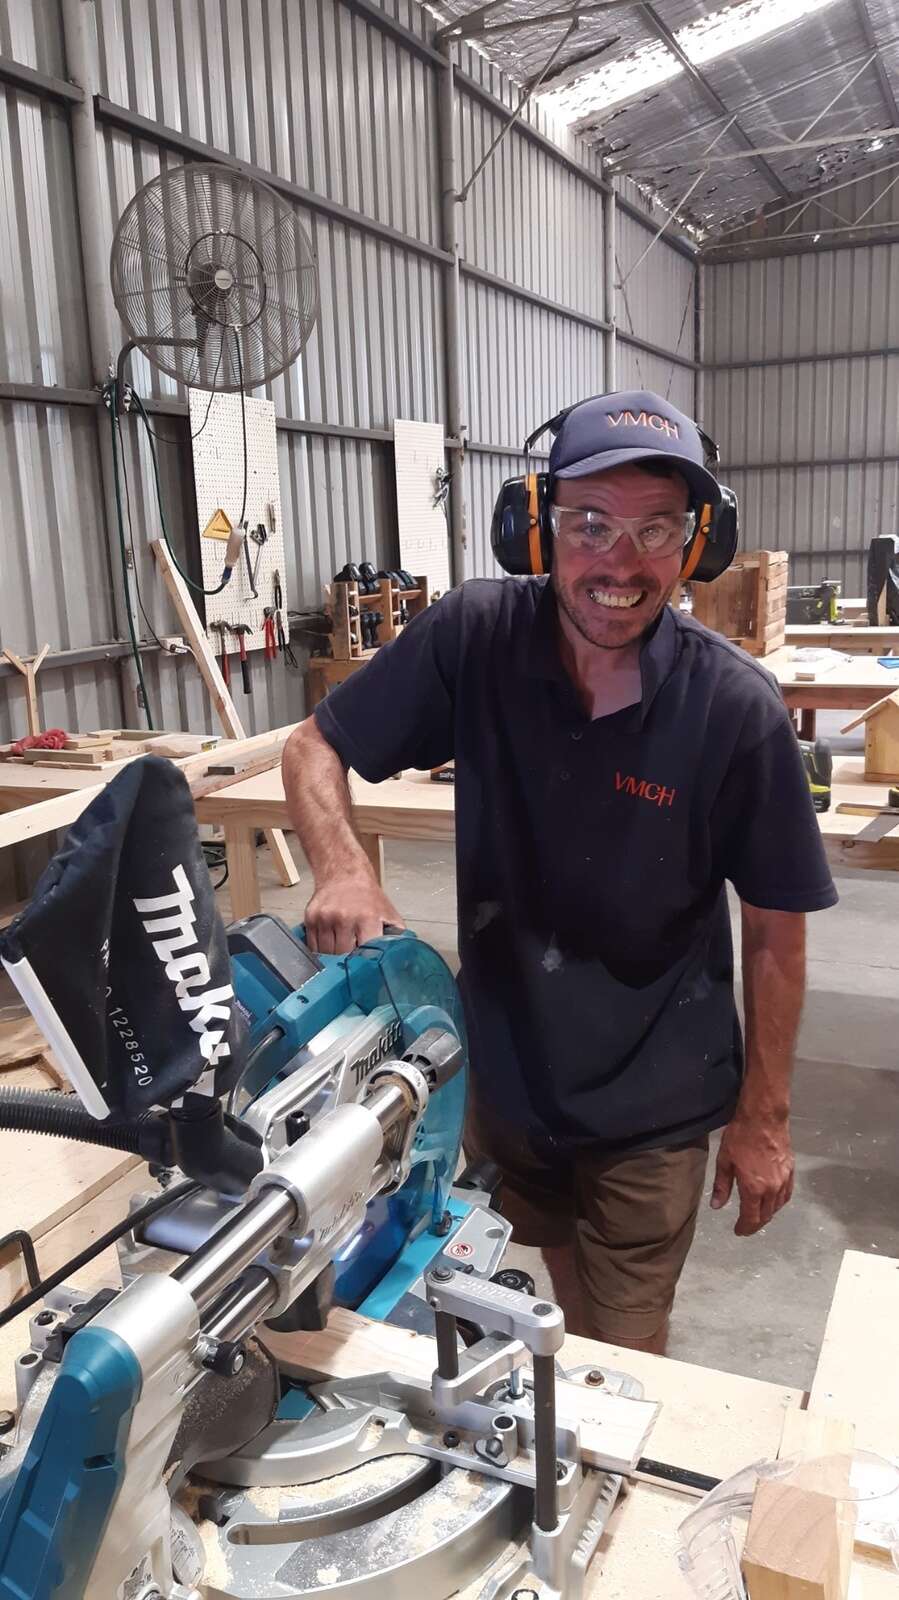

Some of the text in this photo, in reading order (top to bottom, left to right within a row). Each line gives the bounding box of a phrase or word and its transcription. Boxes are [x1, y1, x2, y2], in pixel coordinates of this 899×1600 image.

[607, 409, 679, 440] VMCH
[615, 771, 676, 807] VMCH
[109, 1007, 153, 1086] 1228520
